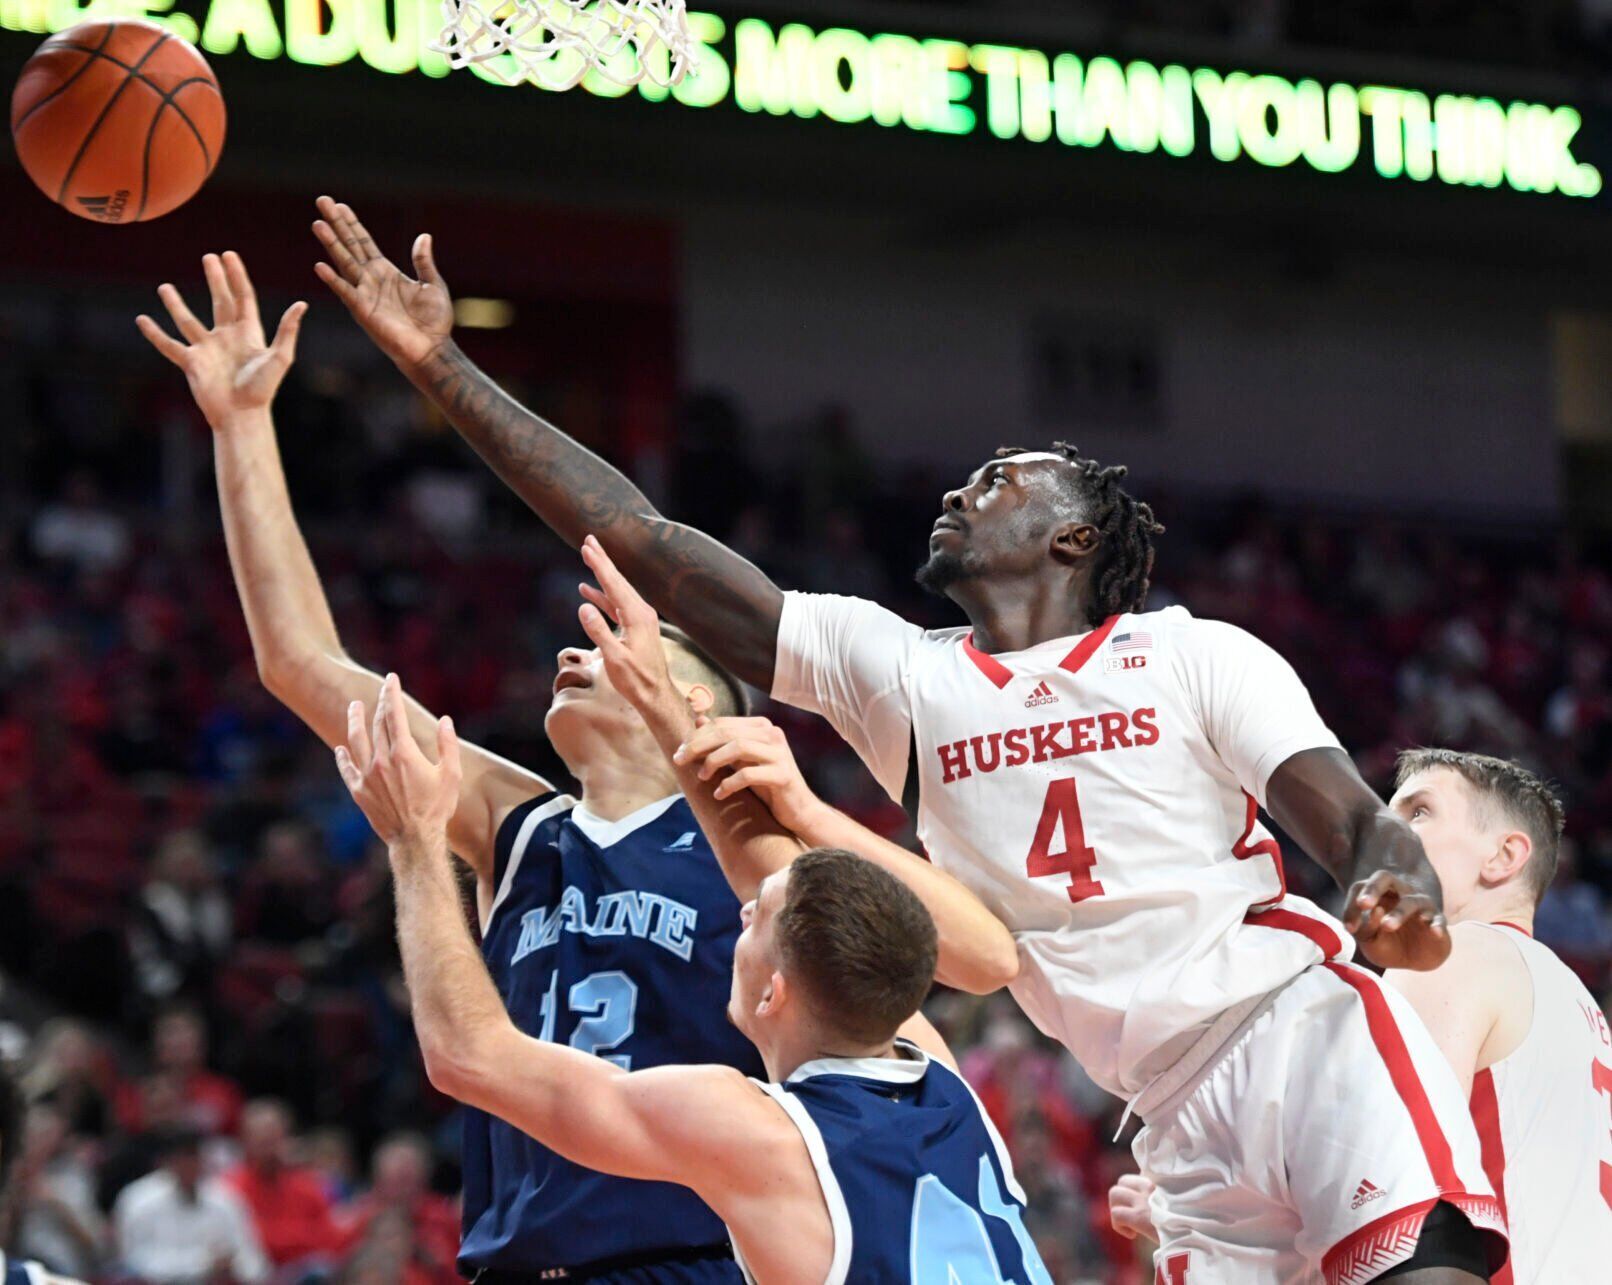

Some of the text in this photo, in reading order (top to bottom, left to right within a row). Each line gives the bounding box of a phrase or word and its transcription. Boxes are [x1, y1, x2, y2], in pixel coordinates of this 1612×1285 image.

[735, 19, 974, 135] MORE
[968, 44, 1193, 157] THAN
[1192, 69, 1359, 172] YOU
[1357, 87, 1601, 197] THINK.
[1024, 695, 1060, 708] adidas
[937, 707, 1160, 784] HUSKERS
[1026, 777, 1105, 903] 4
[510, 885, 698, 966] MAINE
[1351, 1189, 1387, 1210] adidas
